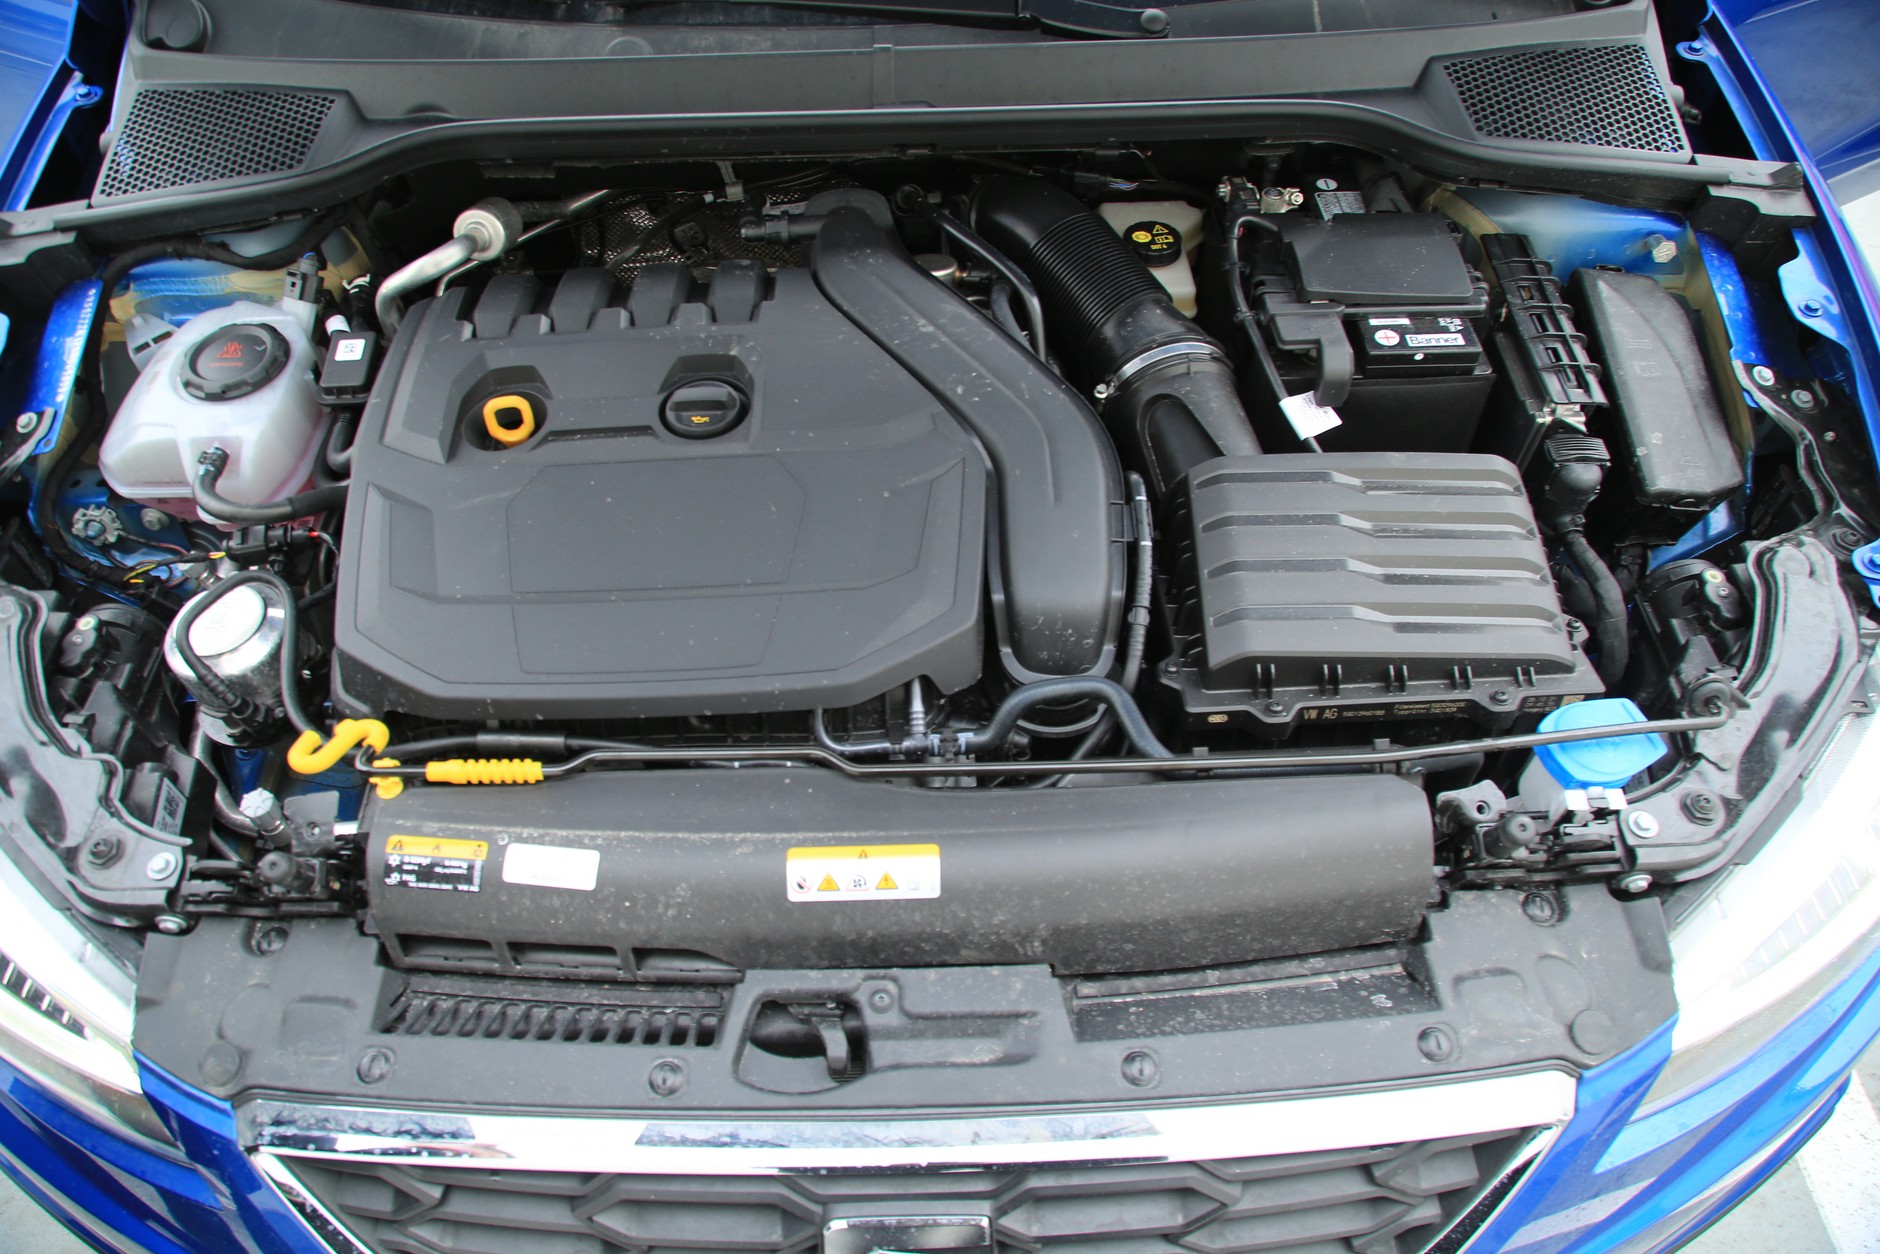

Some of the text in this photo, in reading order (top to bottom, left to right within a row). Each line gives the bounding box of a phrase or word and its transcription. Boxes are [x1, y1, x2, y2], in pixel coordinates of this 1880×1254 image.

[1409, 336, 1459, 345] Banner
[1303, 709, 1319, 720] VW
[1322, 708, 1338, 719] AG
